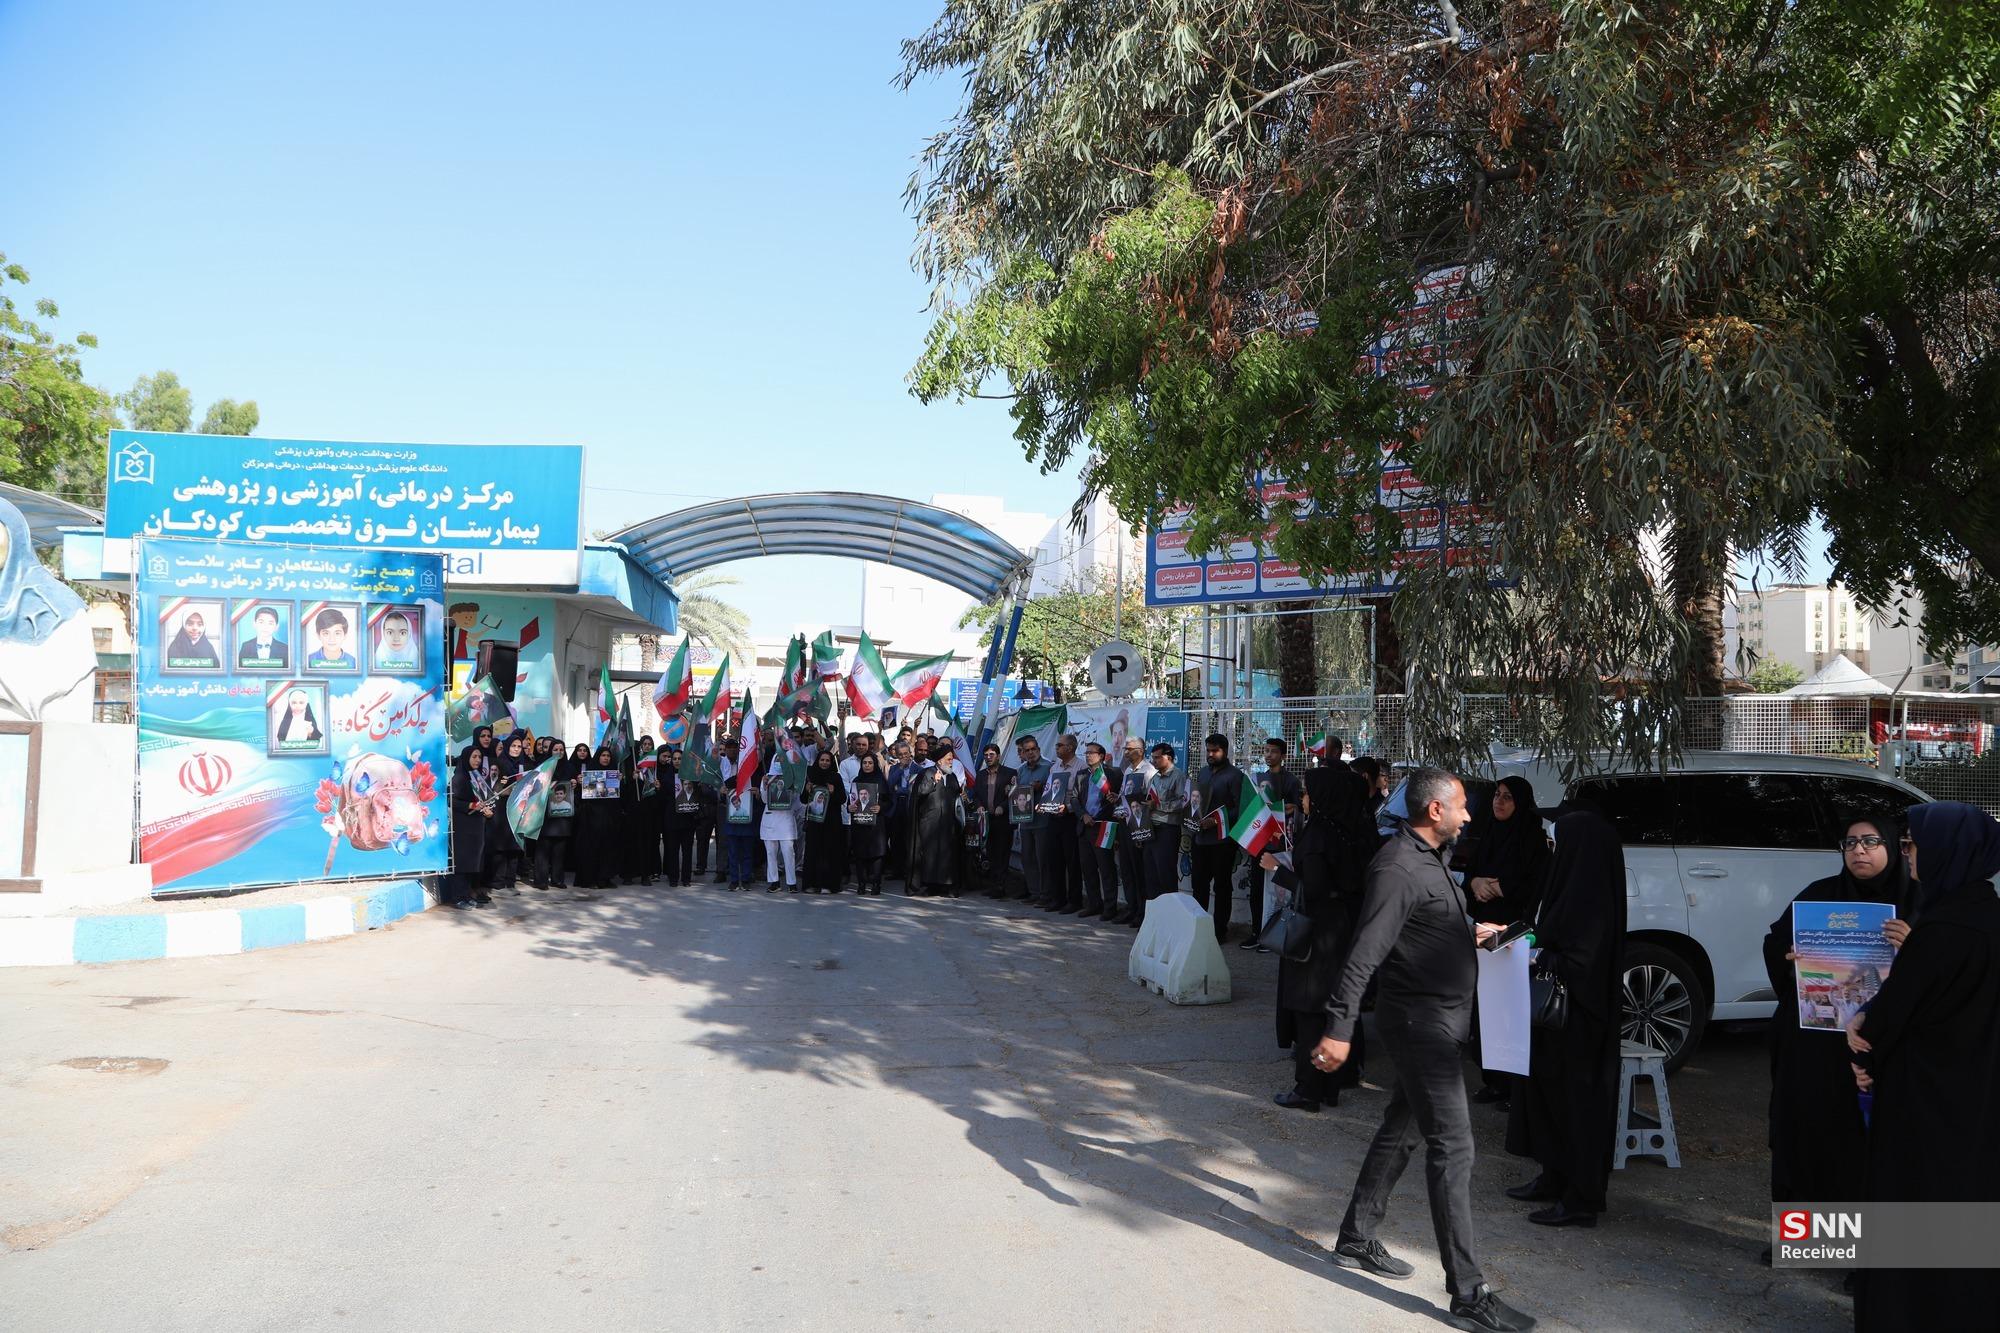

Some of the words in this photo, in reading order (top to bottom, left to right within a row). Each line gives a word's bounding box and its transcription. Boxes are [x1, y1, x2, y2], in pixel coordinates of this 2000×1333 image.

[274, 446, 302, 457] پزشکی
[302, 447, 334, 458] وآموزش
[335, 450, 358, 458] درمان
[359, 450, 393, 461] بهداشت،
[394, 451, 417, 462] وزارت
[242, 459, 275, 469] هرمزگان
[275, 460, 300, 470] درمانی
[305, 461, 338, 471] بهداشتی
[339, 463, 366, 471] خدمات
[372, 464, 398, 473] پزشکی
[399, 465, 419, 473] علوم
[420, 465, 448, 473] دانشگاه
[173, 475, 260, 506] پژوهشی
[264, 485, 277, 505] و
[281, 473, 366, 507] آموزشی
[369, 480, 453, 510] درمانی،
[457, 482, 514, 510] مرکز
[143, 507, 244, 539] کودکان
[246, 512, 353, 540] تخصصی
[354, 513, 418, 544] فوق
[420, 515, 540, 546] بیمارستان
[175, 553, 226, 569] سلامت
[227, 556, 264, 572] کادر
[267, 560, 274, 573] و
[275, 558, 336, 574] دانشگاهیان
[338, 562, 377, 578] بزرگ
[379, 565, 415, 579] تجمع
[174, 570, 209, 587] علمی
[220, 571, 263, 588] درمانی
[266, 575, 299, 592] مراکز
[300, 579, 311, 591] به
[311, 576, 349, 592] حملات
[351, 580, 398, 594] محکومیت
[399, 582, 415, 595] در
[1106, 655, 1127, 684] P
[146, 684, 176, 697] میناب
[176, 681, 200, 696] آموز
[200, 684, 227, 697] دانش
[229, 685, 261, 696] شهدای
[345, 691, 392, 732] گناه
